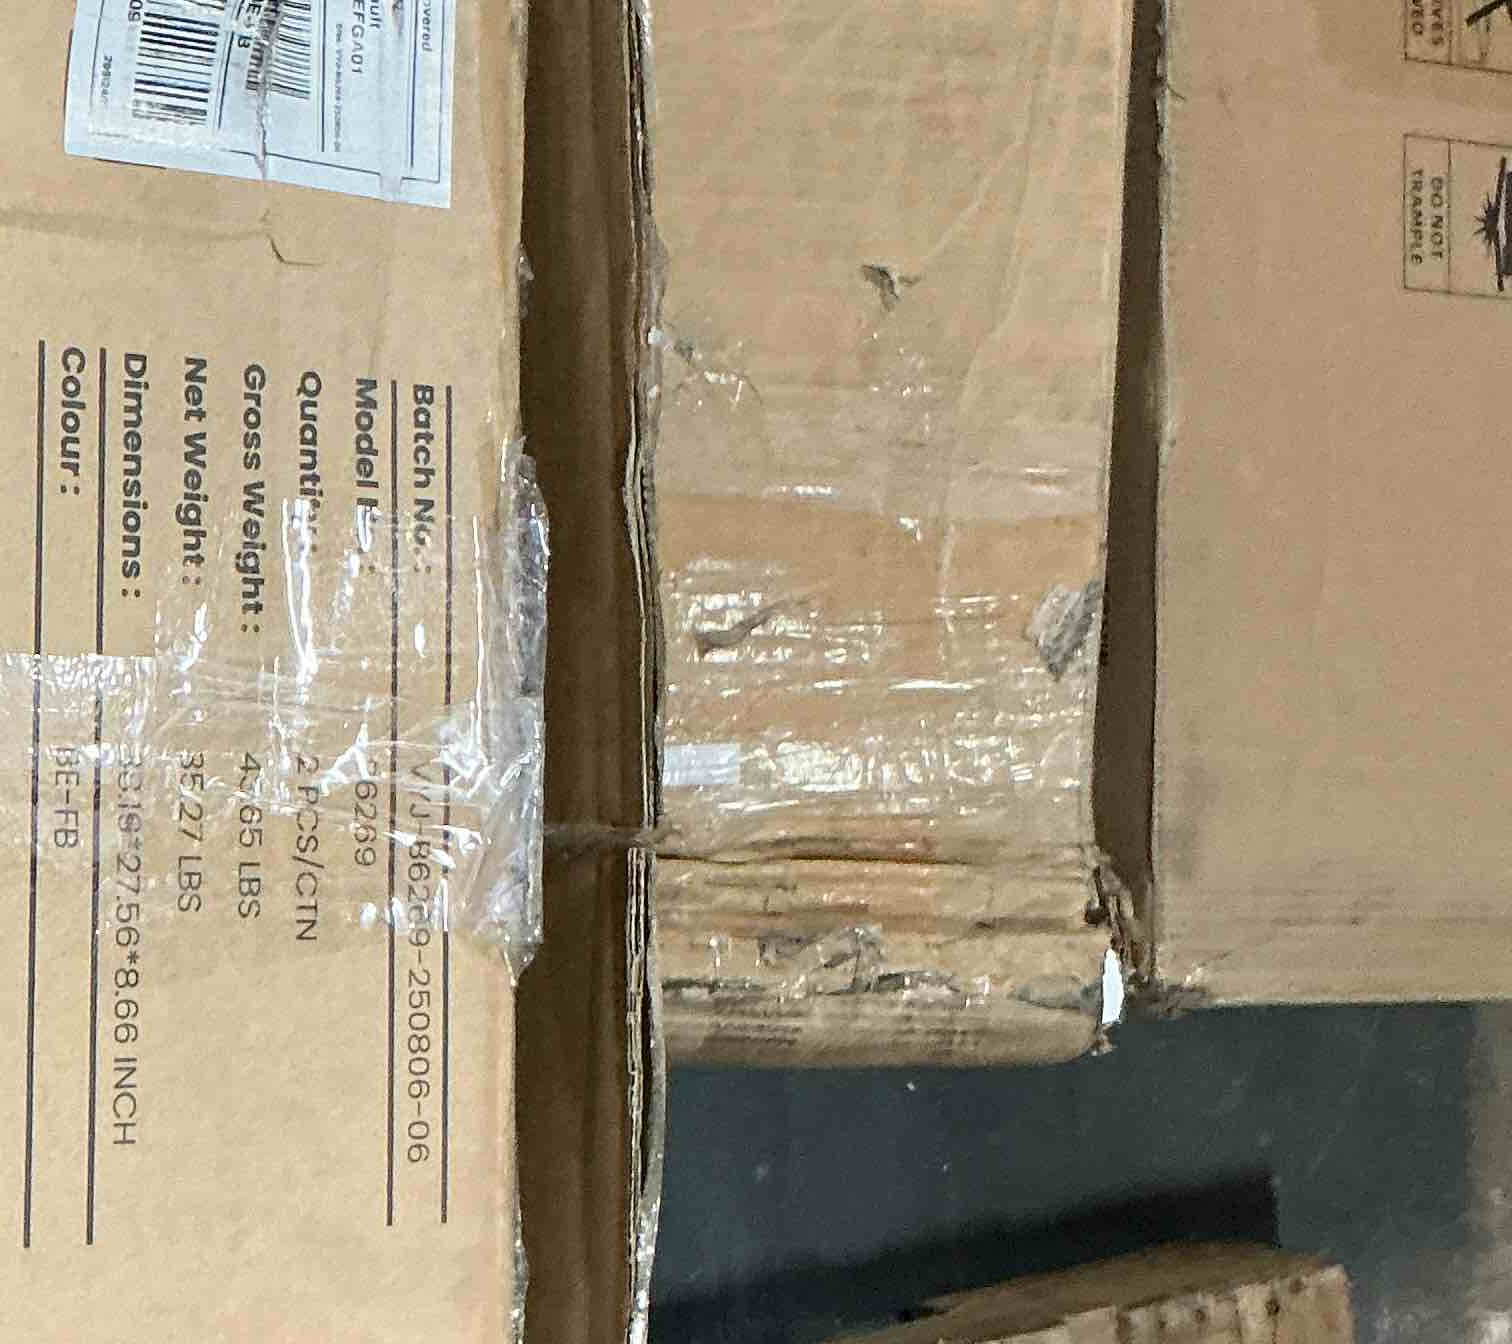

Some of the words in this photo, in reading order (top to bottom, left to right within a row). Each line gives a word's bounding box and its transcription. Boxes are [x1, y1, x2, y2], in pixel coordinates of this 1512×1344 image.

[1410, 169, 1424, 265] TRAMPLE
[1430, 176, 1444, 208] DO
[1430, 215, 1443, 261] NOT
[60, 347, 87, 477] Colour
[183, 357, 208, 421] Net
[243, 364, 267, 470] Gross
[354, 377, 379, 488] Model
[413, 383, 435, 489] Batch
[121, 353, 150, 580] Dimensions
[175, 432, 209, 568] Weight
[234, 481, 267, 615] Weight
[413, 498, 435, 555] No.
[53, 747, 80, 849] BE-FB
[296, 756, 320, 775] 2
[354, 761, 378, 866] 6269
[176, 856, 202, 914] LBS
[237, 861, 261, 919] LBS
[291, 786, 325, 942] PCS/CTN
[111, 1057, 138, 1146] INCH
